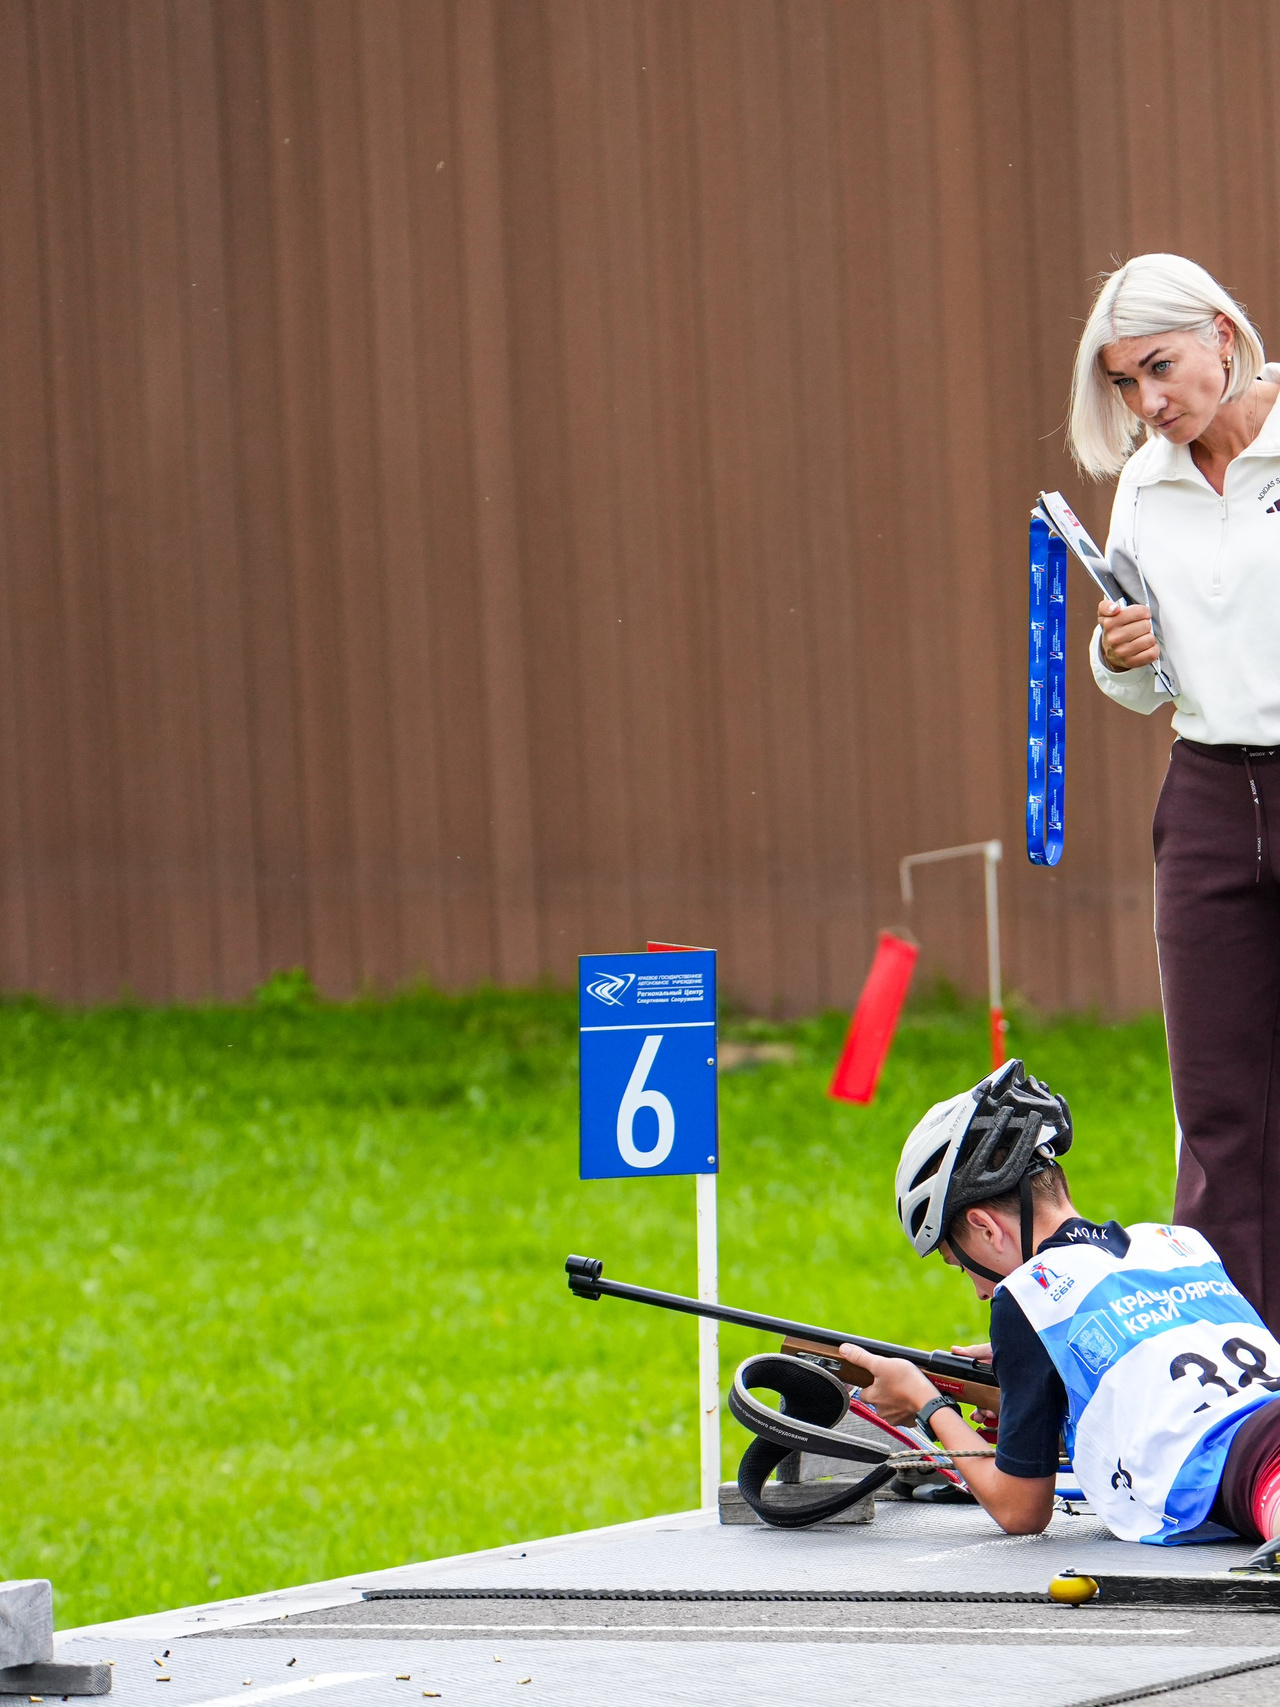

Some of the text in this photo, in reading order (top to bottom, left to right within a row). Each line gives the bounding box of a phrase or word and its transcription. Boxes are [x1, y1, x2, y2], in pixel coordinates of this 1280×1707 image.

[1258, 480, 1275, 501] ADIDAS
[637, 989, 682, 997] Региональный
[616, 1035, 675, 1169] 6
[1053, 1279, 1075, 1302] СБР
[1123, 1300, 1182, 1335] КРАЙ
[769, 1425, 809, 1442] оборудования
